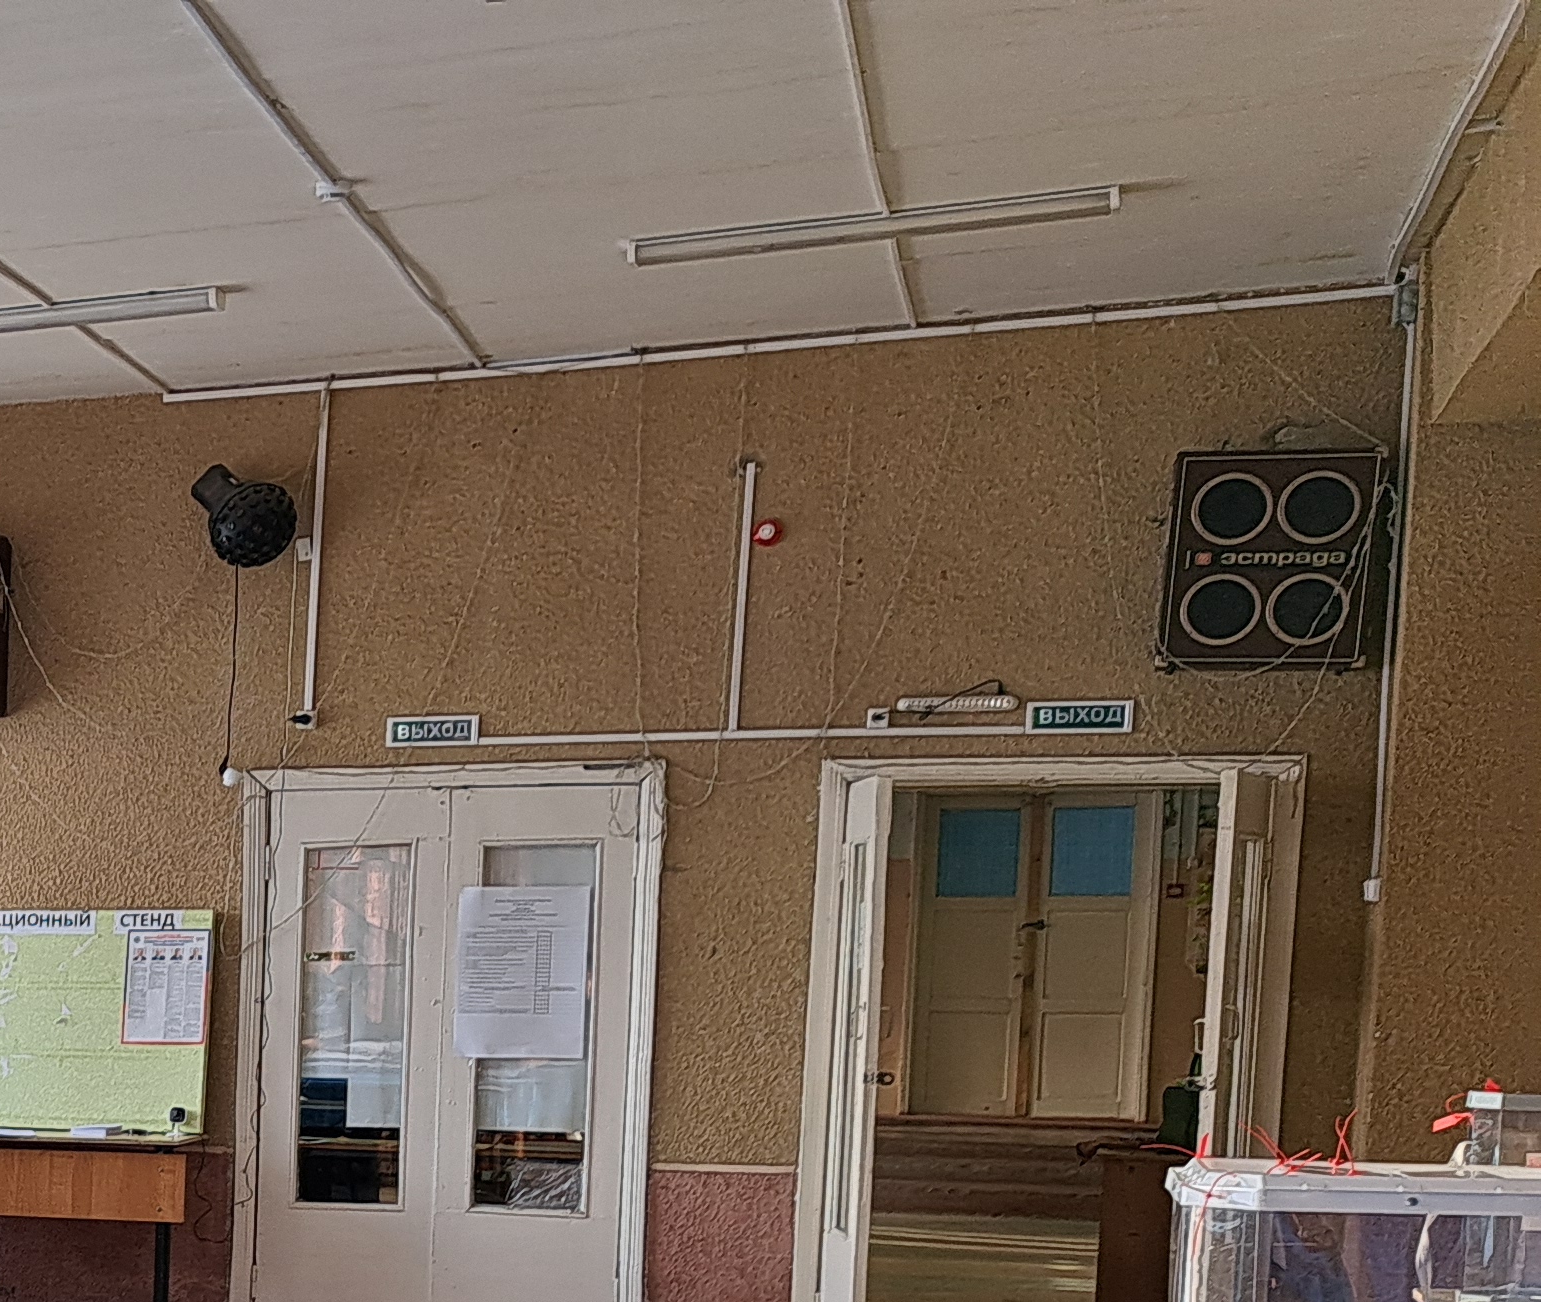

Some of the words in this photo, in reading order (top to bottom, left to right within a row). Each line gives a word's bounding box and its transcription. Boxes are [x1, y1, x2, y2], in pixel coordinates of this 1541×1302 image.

[1039, 706, 1122, 725] ВЫХОД
[397, 722, 469, 740] ВЫХОД
[120, 912, 175, 930] СТЕНД
